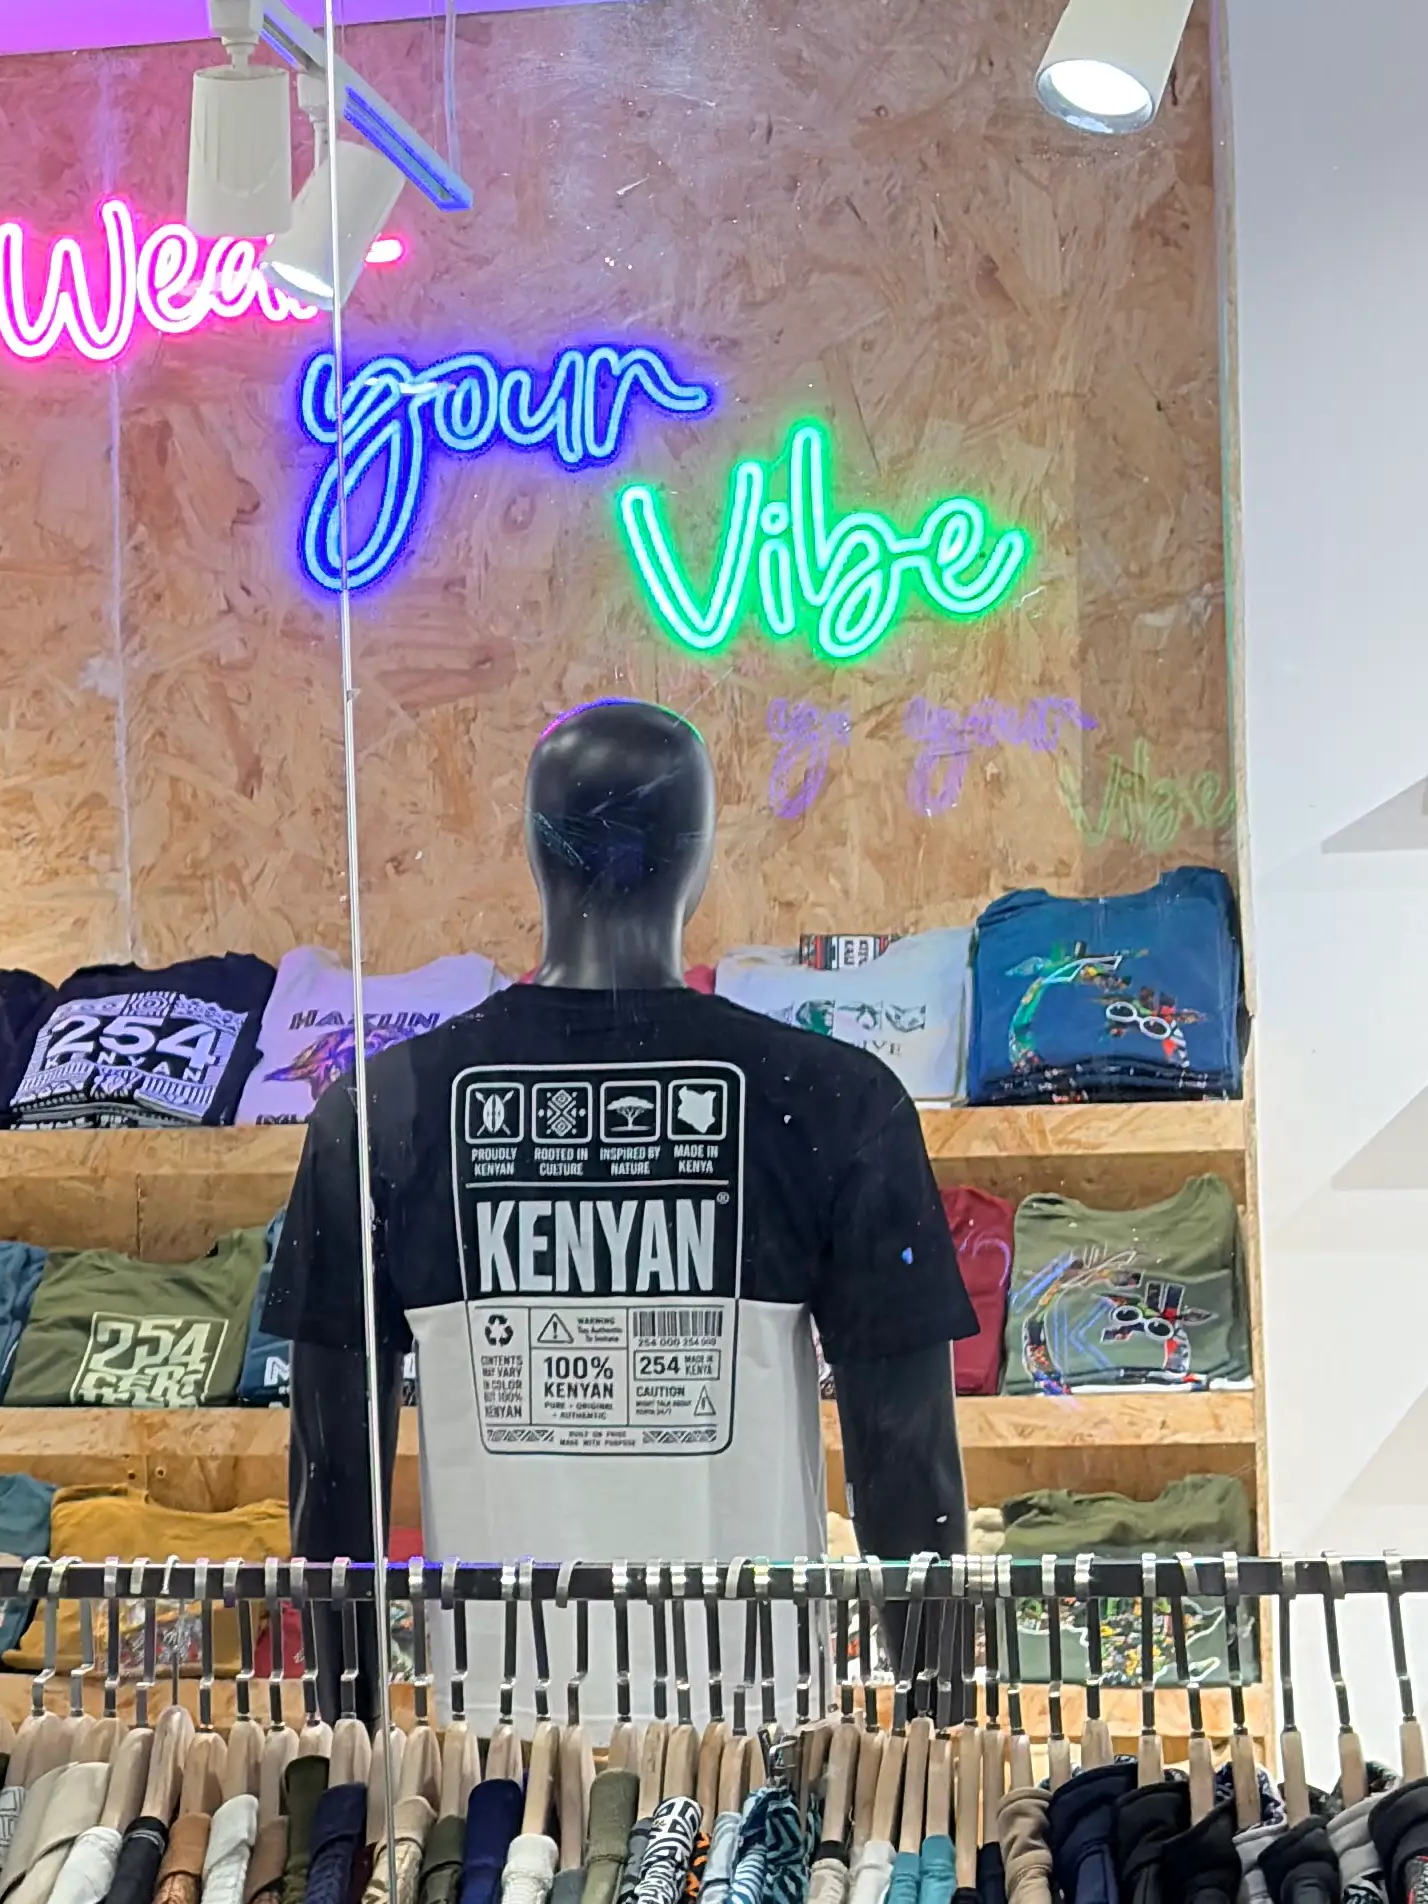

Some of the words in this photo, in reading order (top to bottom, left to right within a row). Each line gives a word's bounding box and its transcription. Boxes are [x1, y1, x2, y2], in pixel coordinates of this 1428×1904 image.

[302, 346, 710, 594] your
[621, 424, 1026, 658] Vibe
[45, 1014, 217, 1071] 254
[471, 1147, 518, 1162] PROUDLY
[534, 1147, 574, 1161] ROOTED
[576, 1147, 589, 1161] IN
[599, 1146, 646, 1161] INSPIRED
[647, 1144, 661, 1160] BY
[674, 1144, 704, 1158] MADE
[706, 1145, 719, 1158] IN
[474, 1162, 515, 1177] KENYAN
[539, 1162, 584, 1176] CULTURE
[610, 1161, 651, 1176] NATURE
[678, 1159, 714, 1174] KENYA
[87, 1318, 211, 1374] 254
[544, 1356, 614, 1380] 100%
[640, 1356, 680, 1374] 254
[544, 1382, 614, 1399] KENYAN
[636, 1386, 685, 1397] CAUTION
